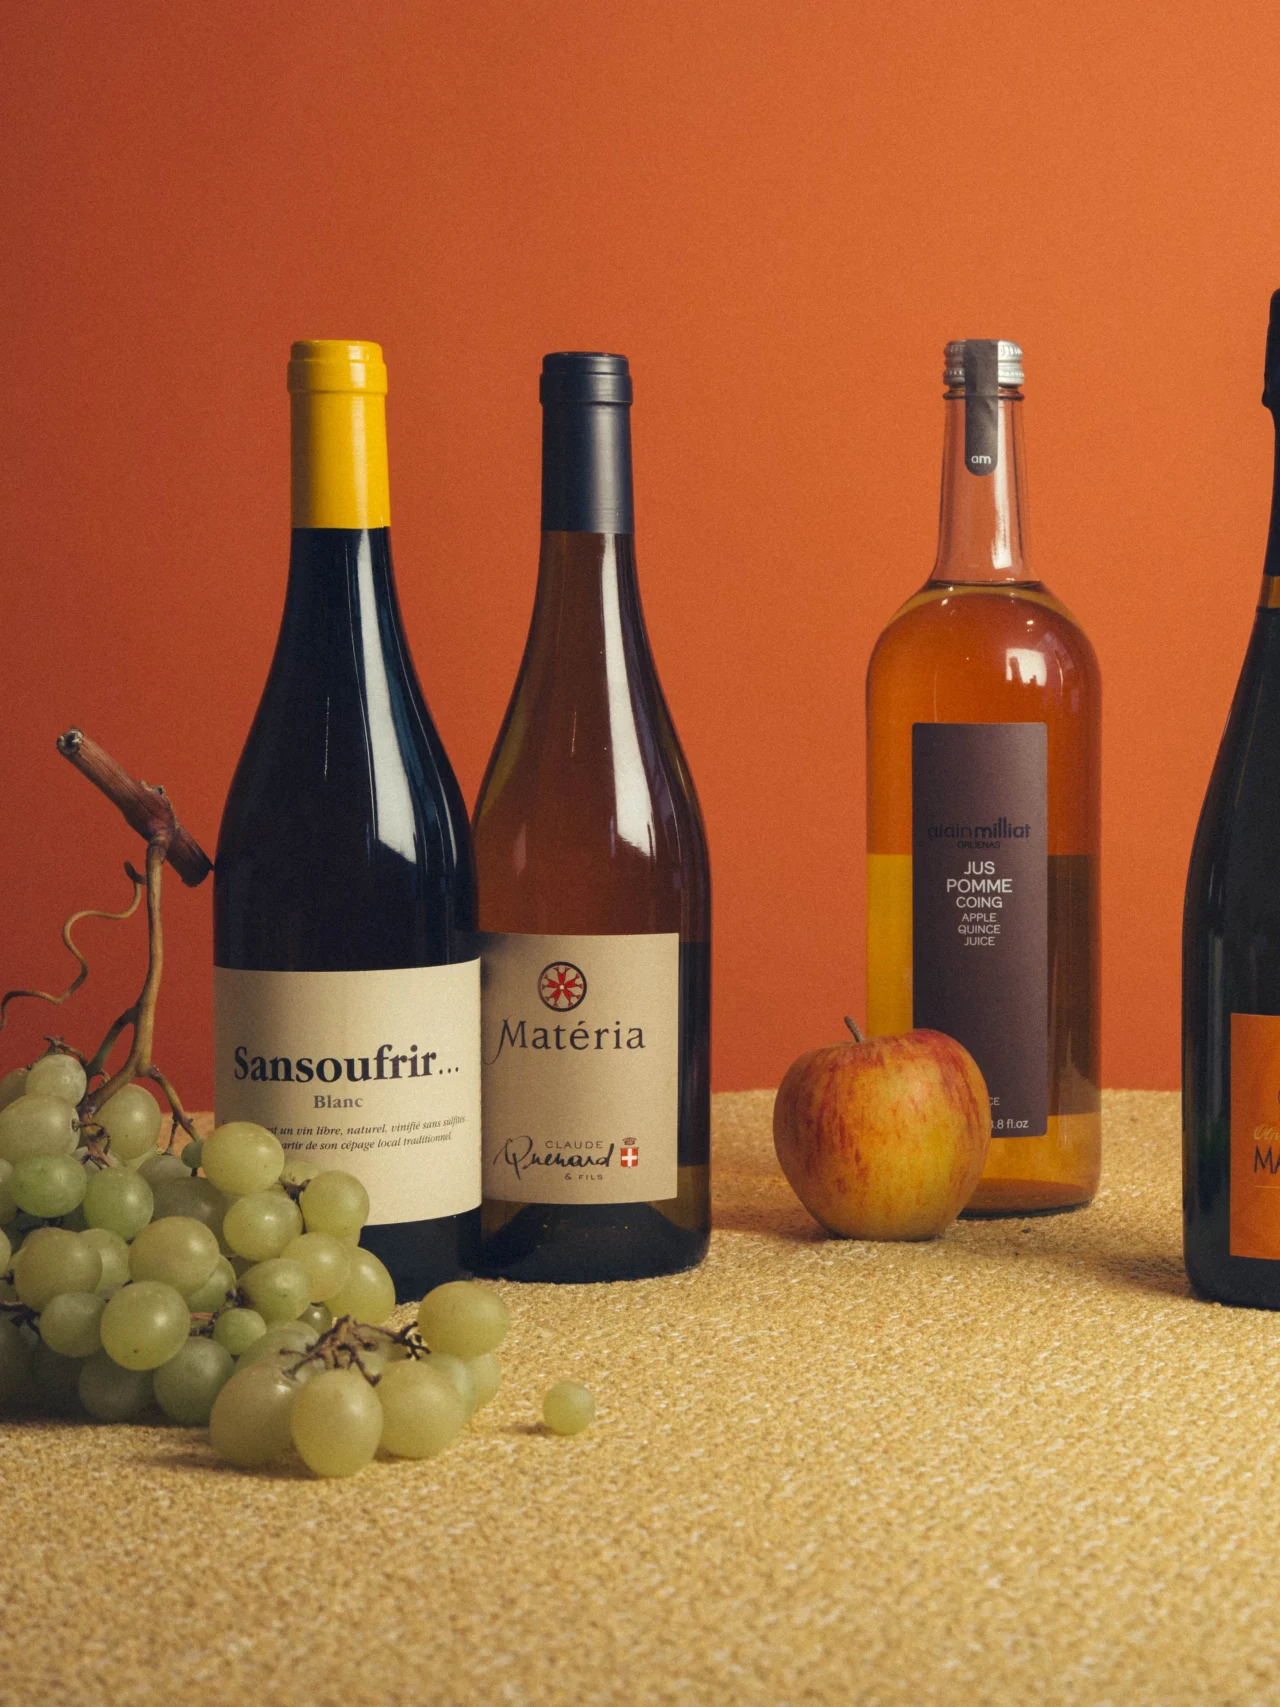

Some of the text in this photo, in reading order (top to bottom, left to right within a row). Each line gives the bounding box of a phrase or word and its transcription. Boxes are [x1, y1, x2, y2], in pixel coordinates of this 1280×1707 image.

[971, 455, 992, 464] am
[963, 861, 995, 875] JUS
[946, 878, 1013, 893] POMME
[956, 896, 1003, 909] COING
[961, 912, 997, 923] APPLE
[957, 924, 1001, 935] QUINCE
[964, 936, 996, 946] JUICE
[483, 1015, 647, 1065] Matéria
[313, 1094, 364, 1109] Blanc
[280, 1127, 294, 1136] un
[296, 1126, 313, 1136] vin
[316, 1125, 343, 1137] libre,
[346, 1123, 388, 1135] naturel,
[422, 1119, 442, 1130] sans
[442, 1115, 466, 1128] sulfites
[305, 1140, 317, 1150] de
[319, 1142, 338, 1150] son
[340, 1139, 375, 1152] cépage
[377, 1136, 402, 1148] local
[545, 1140, 604, 1150] CLAUDE
